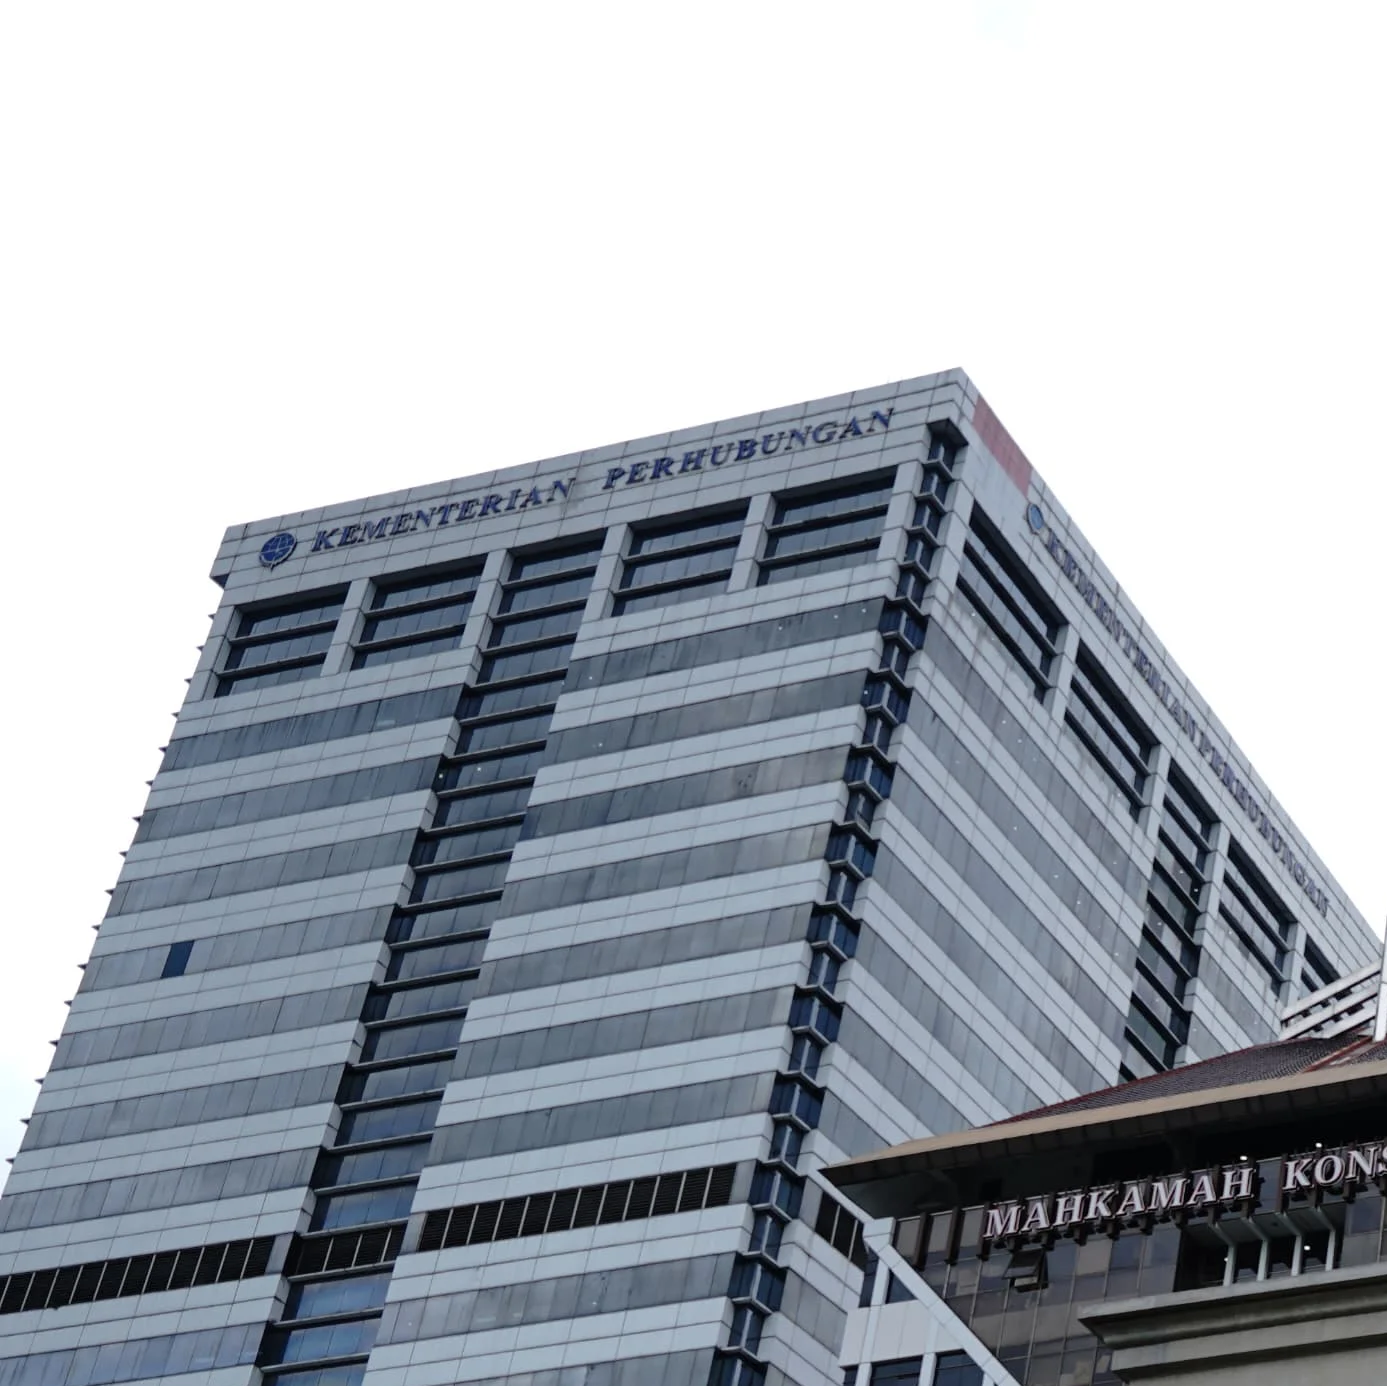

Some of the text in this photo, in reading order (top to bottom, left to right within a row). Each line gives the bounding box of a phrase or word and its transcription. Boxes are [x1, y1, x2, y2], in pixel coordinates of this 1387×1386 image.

[311, 407, 895, 552] KEMENTERIAN PERHUBUNGAN
[982, 1167, 1255, 1239] MAHKAMAH
